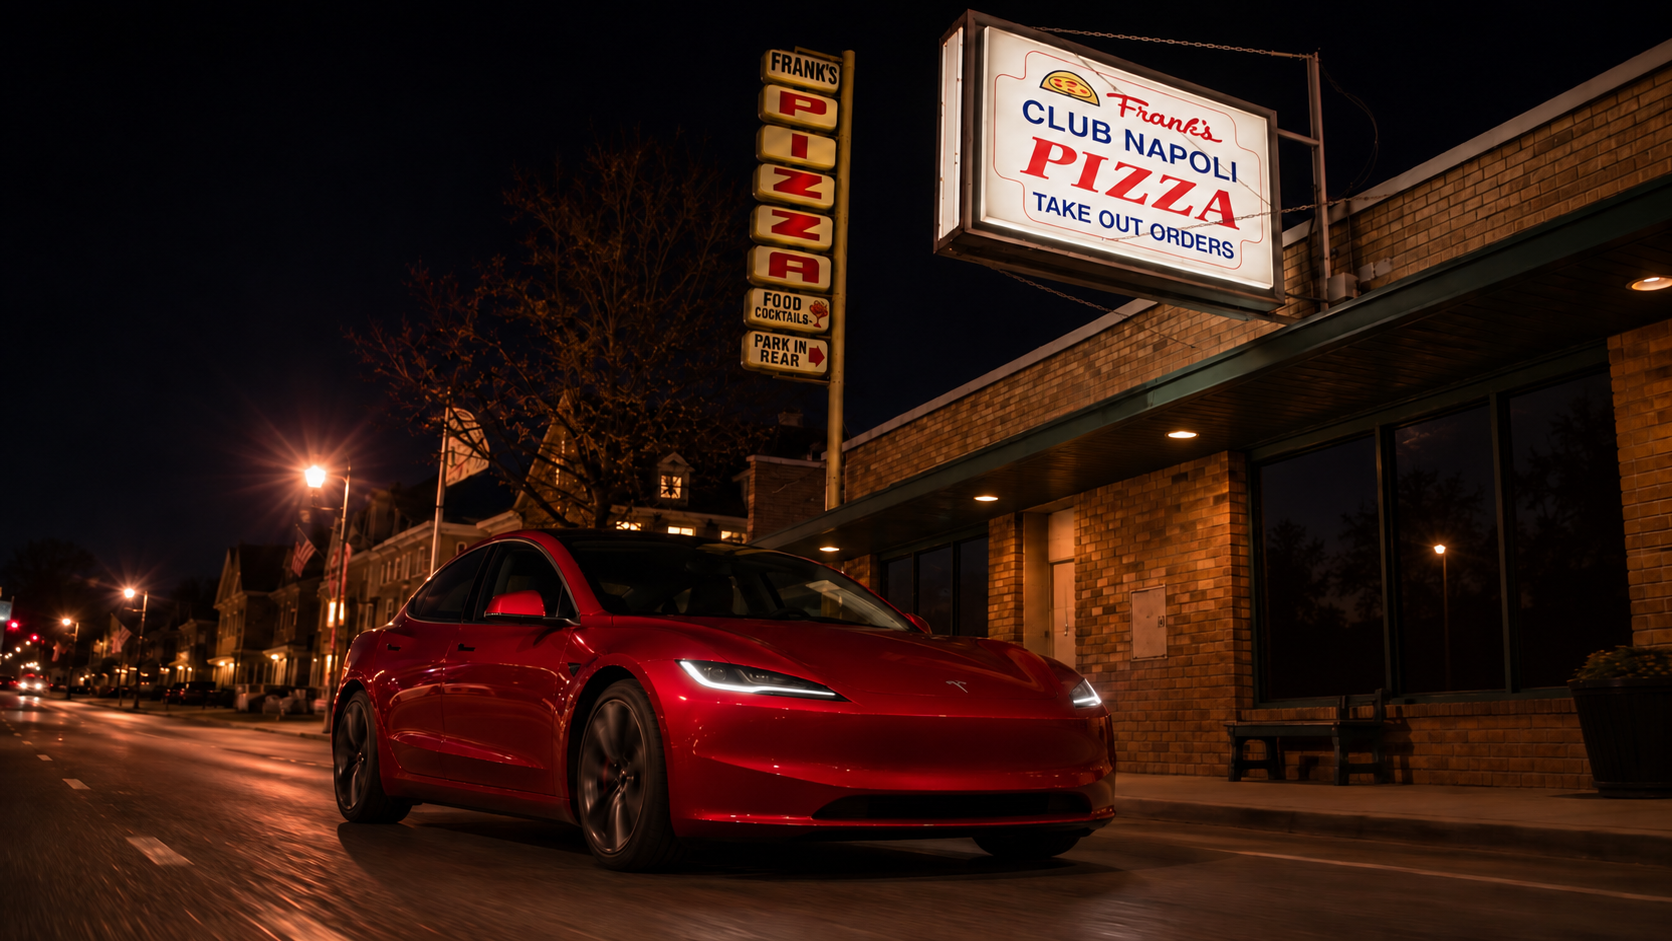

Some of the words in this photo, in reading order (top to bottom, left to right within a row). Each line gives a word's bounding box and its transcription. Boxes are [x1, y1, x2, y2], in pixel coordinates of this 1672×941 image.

[771, 51, 838, 84] FRANK'S
[1022, 99, 1112, 145] CLUB
[1124, 128, 1238, 183] NAPOLI
[1106, 92, 1223, 144] Frank's
[768, 90, 827, 284] PIZZA
[1019, 136, 1241, 231] PIZZA
[1032, 191, 1092, 224] TAKE
[1098, 209, 1144, 236] OUT
[1149, 222, 1235, 260] ORDERS
[763, 291, 802, 311] FOOD
[754, 333, 790, 351] PARK
[794, 339, 807, 354] IN
[760, 349, 800, 367] REAR
